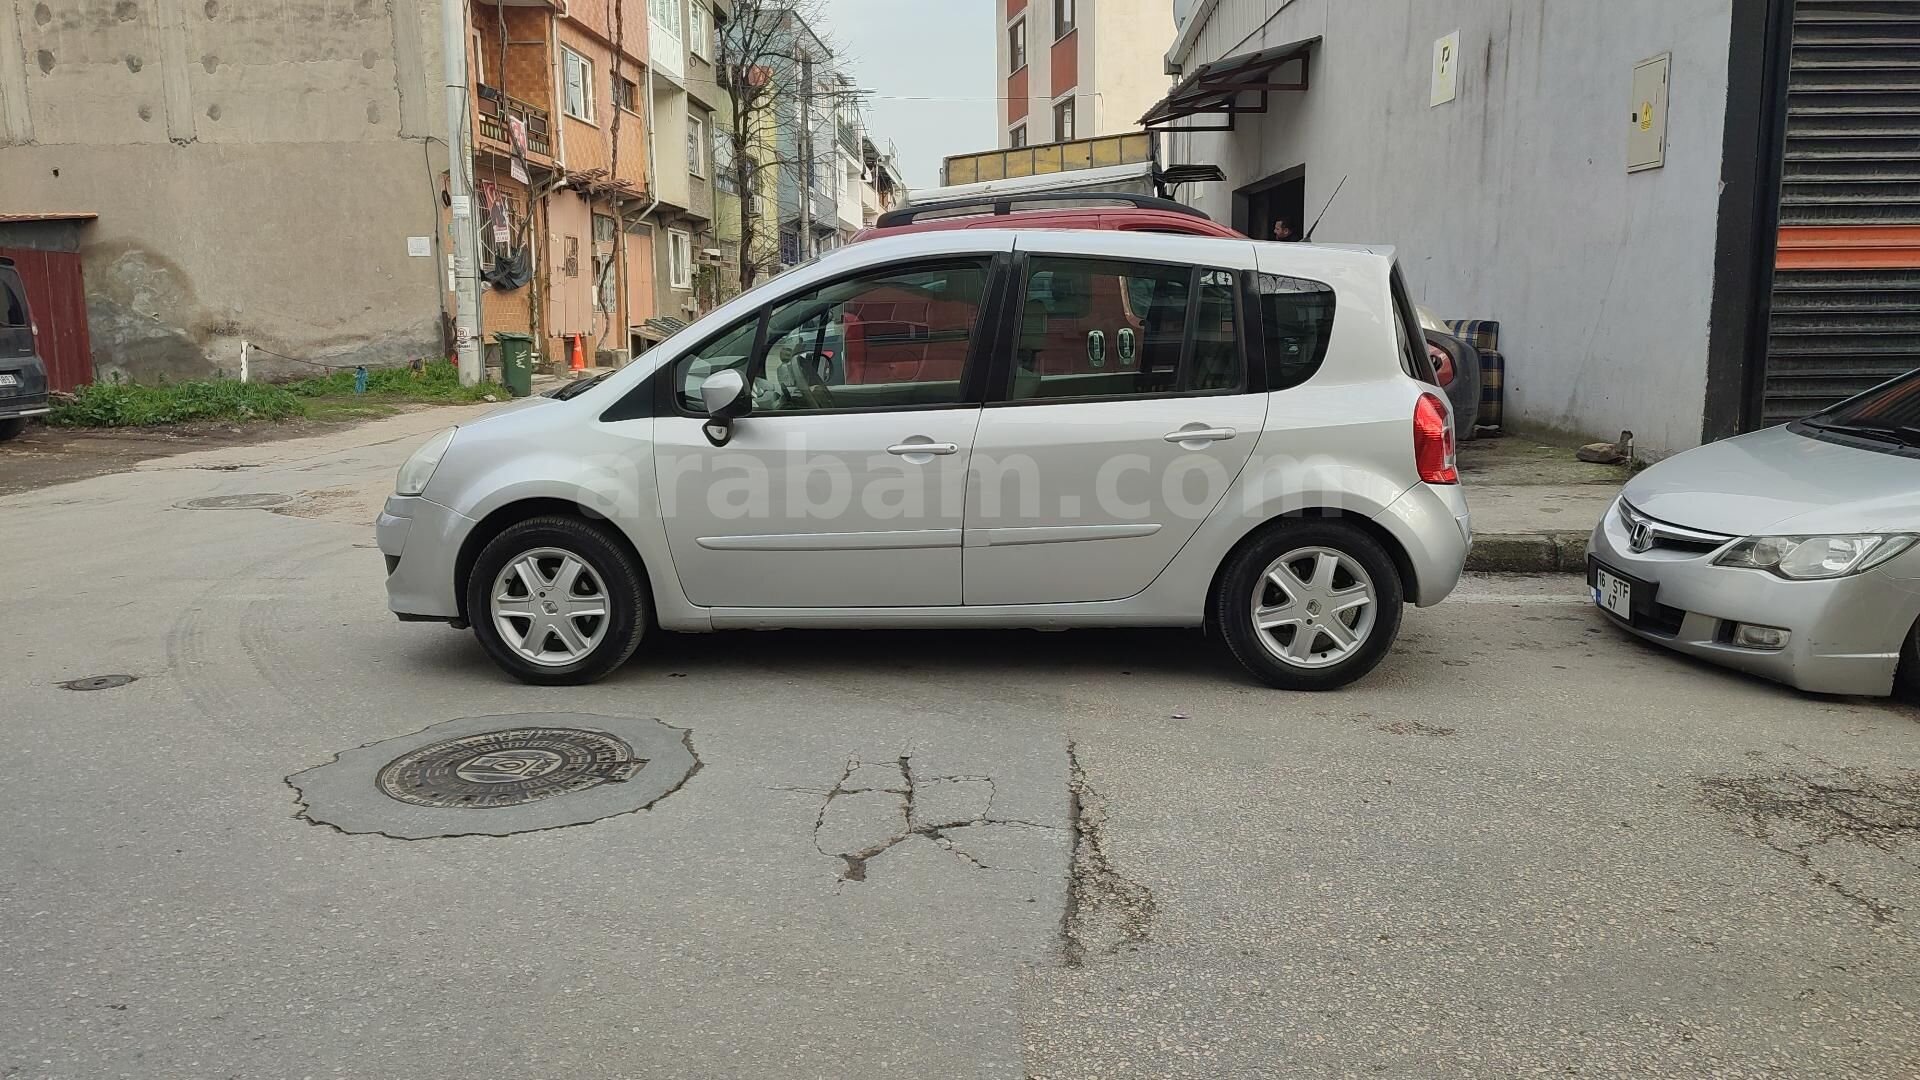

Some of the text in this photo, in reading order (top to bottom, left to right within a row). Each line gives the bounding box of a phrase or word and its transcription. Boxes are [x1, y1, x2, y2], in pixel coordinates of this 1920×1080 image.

[1599, 571, 1629, 598] 16 STF
[1607, 594, 1617, 610] 47
